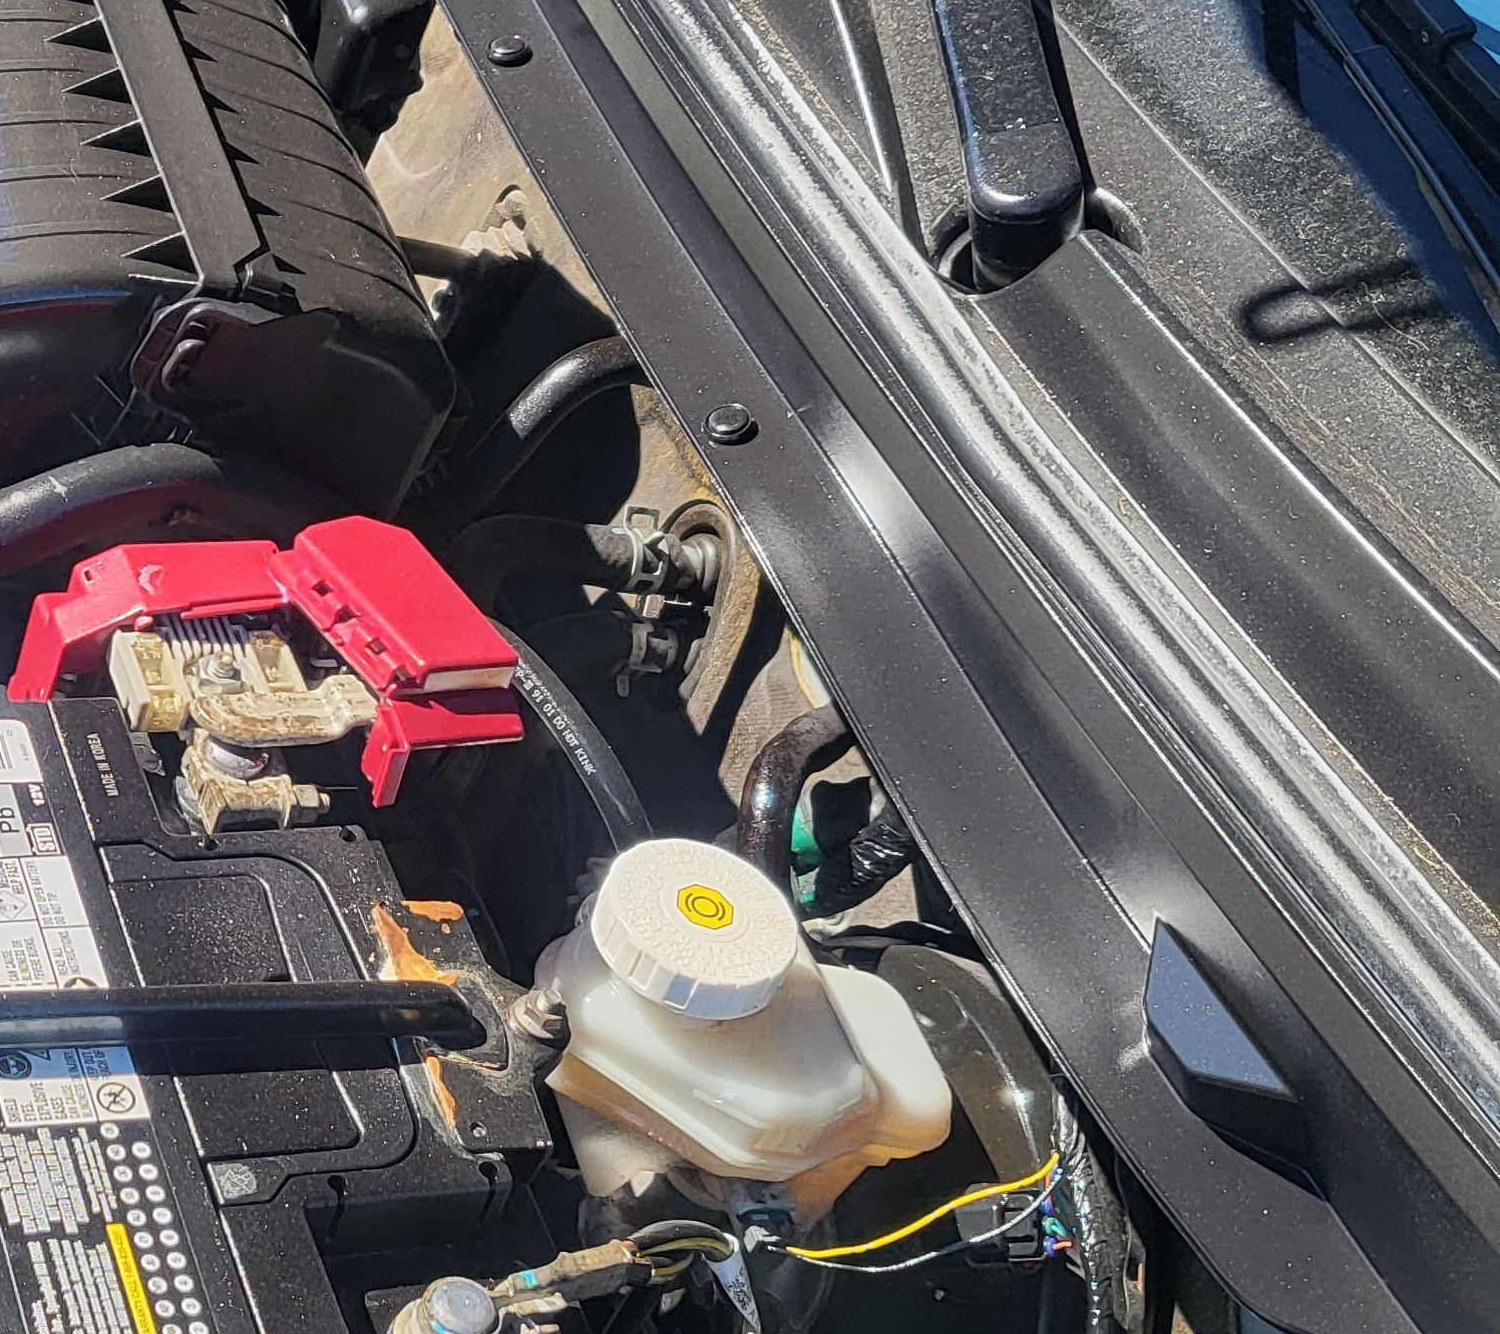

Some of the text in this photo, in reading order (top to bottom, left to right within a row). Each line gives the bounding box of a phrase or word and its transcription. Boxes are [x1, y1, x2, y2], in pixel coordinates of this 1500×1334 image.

[87, 733, 119, 796] MADE IN KOREA
[553, 717, 565, 729] DO
[562, 730, 579, 747] NOT
[575, 748, 596, 775] KINK
[27, 783, 46, 805] 12V
